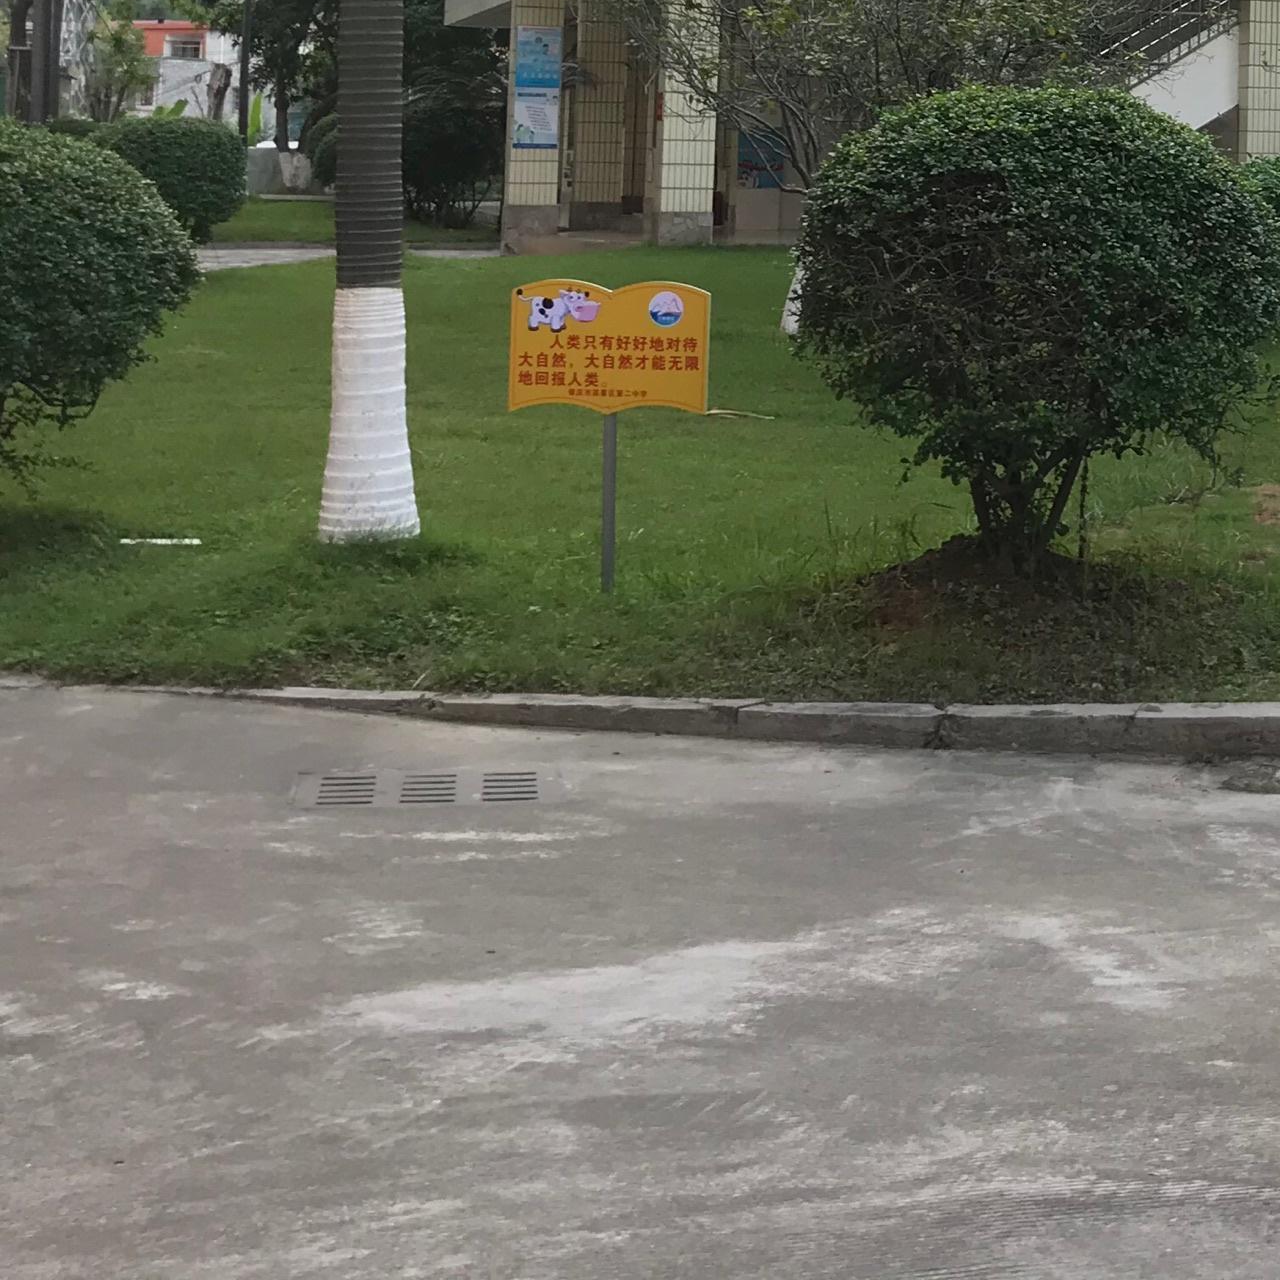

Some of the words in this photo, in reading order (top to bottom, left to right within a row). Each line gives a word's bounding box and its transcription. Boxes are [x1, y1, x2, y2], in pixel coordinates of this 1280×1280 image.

[549, 334, 698, 353] 人类只有好好地对待
